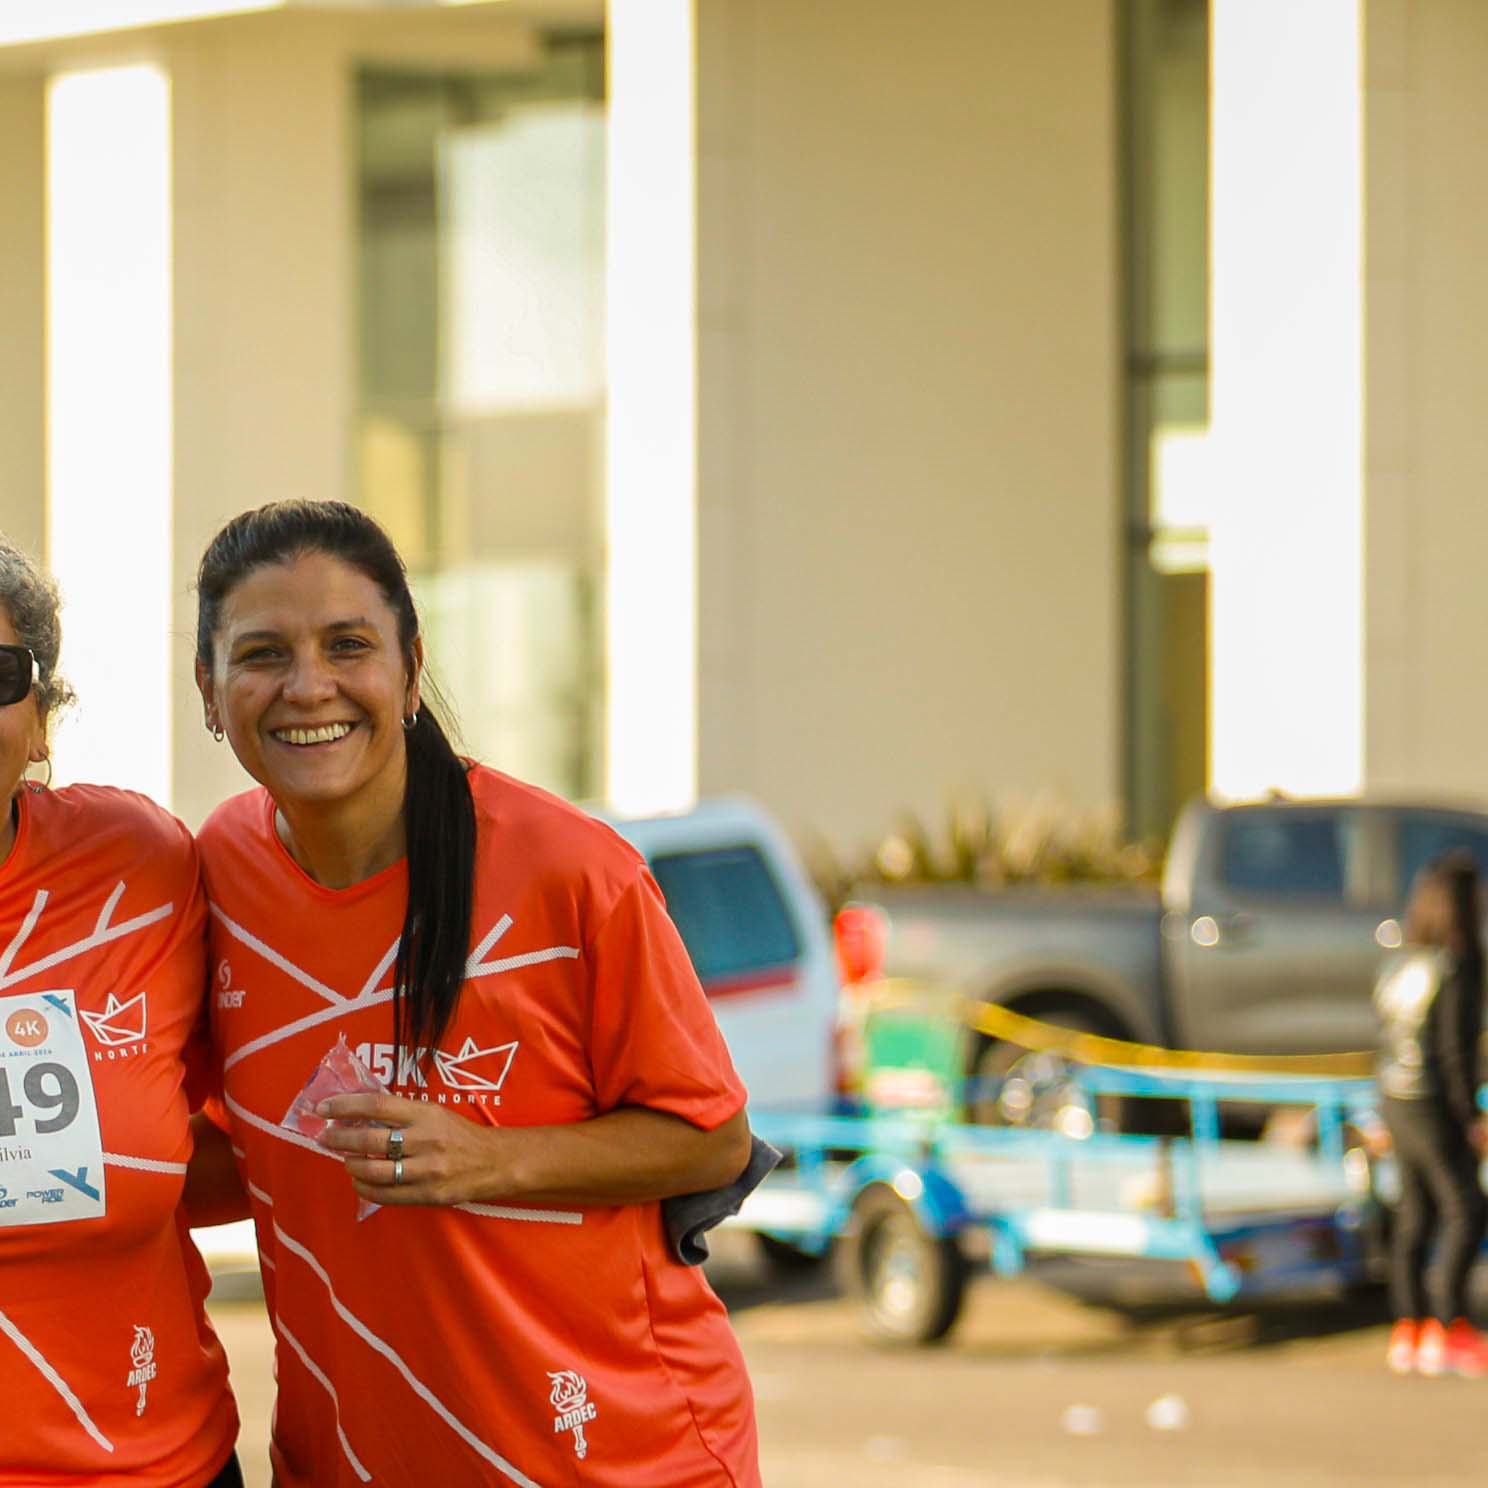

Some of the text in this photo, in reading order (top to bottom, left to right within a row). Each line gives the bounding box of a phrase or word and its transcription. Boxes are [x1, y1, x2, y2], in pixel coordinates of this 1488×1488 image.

[14, 1014, 41, 1036] 4K
[356, 1043, 428, 1087] 15K
[127, 1362, 157, 1387] ARDEC
[554, 1402, 597, 1433] ARDEC
